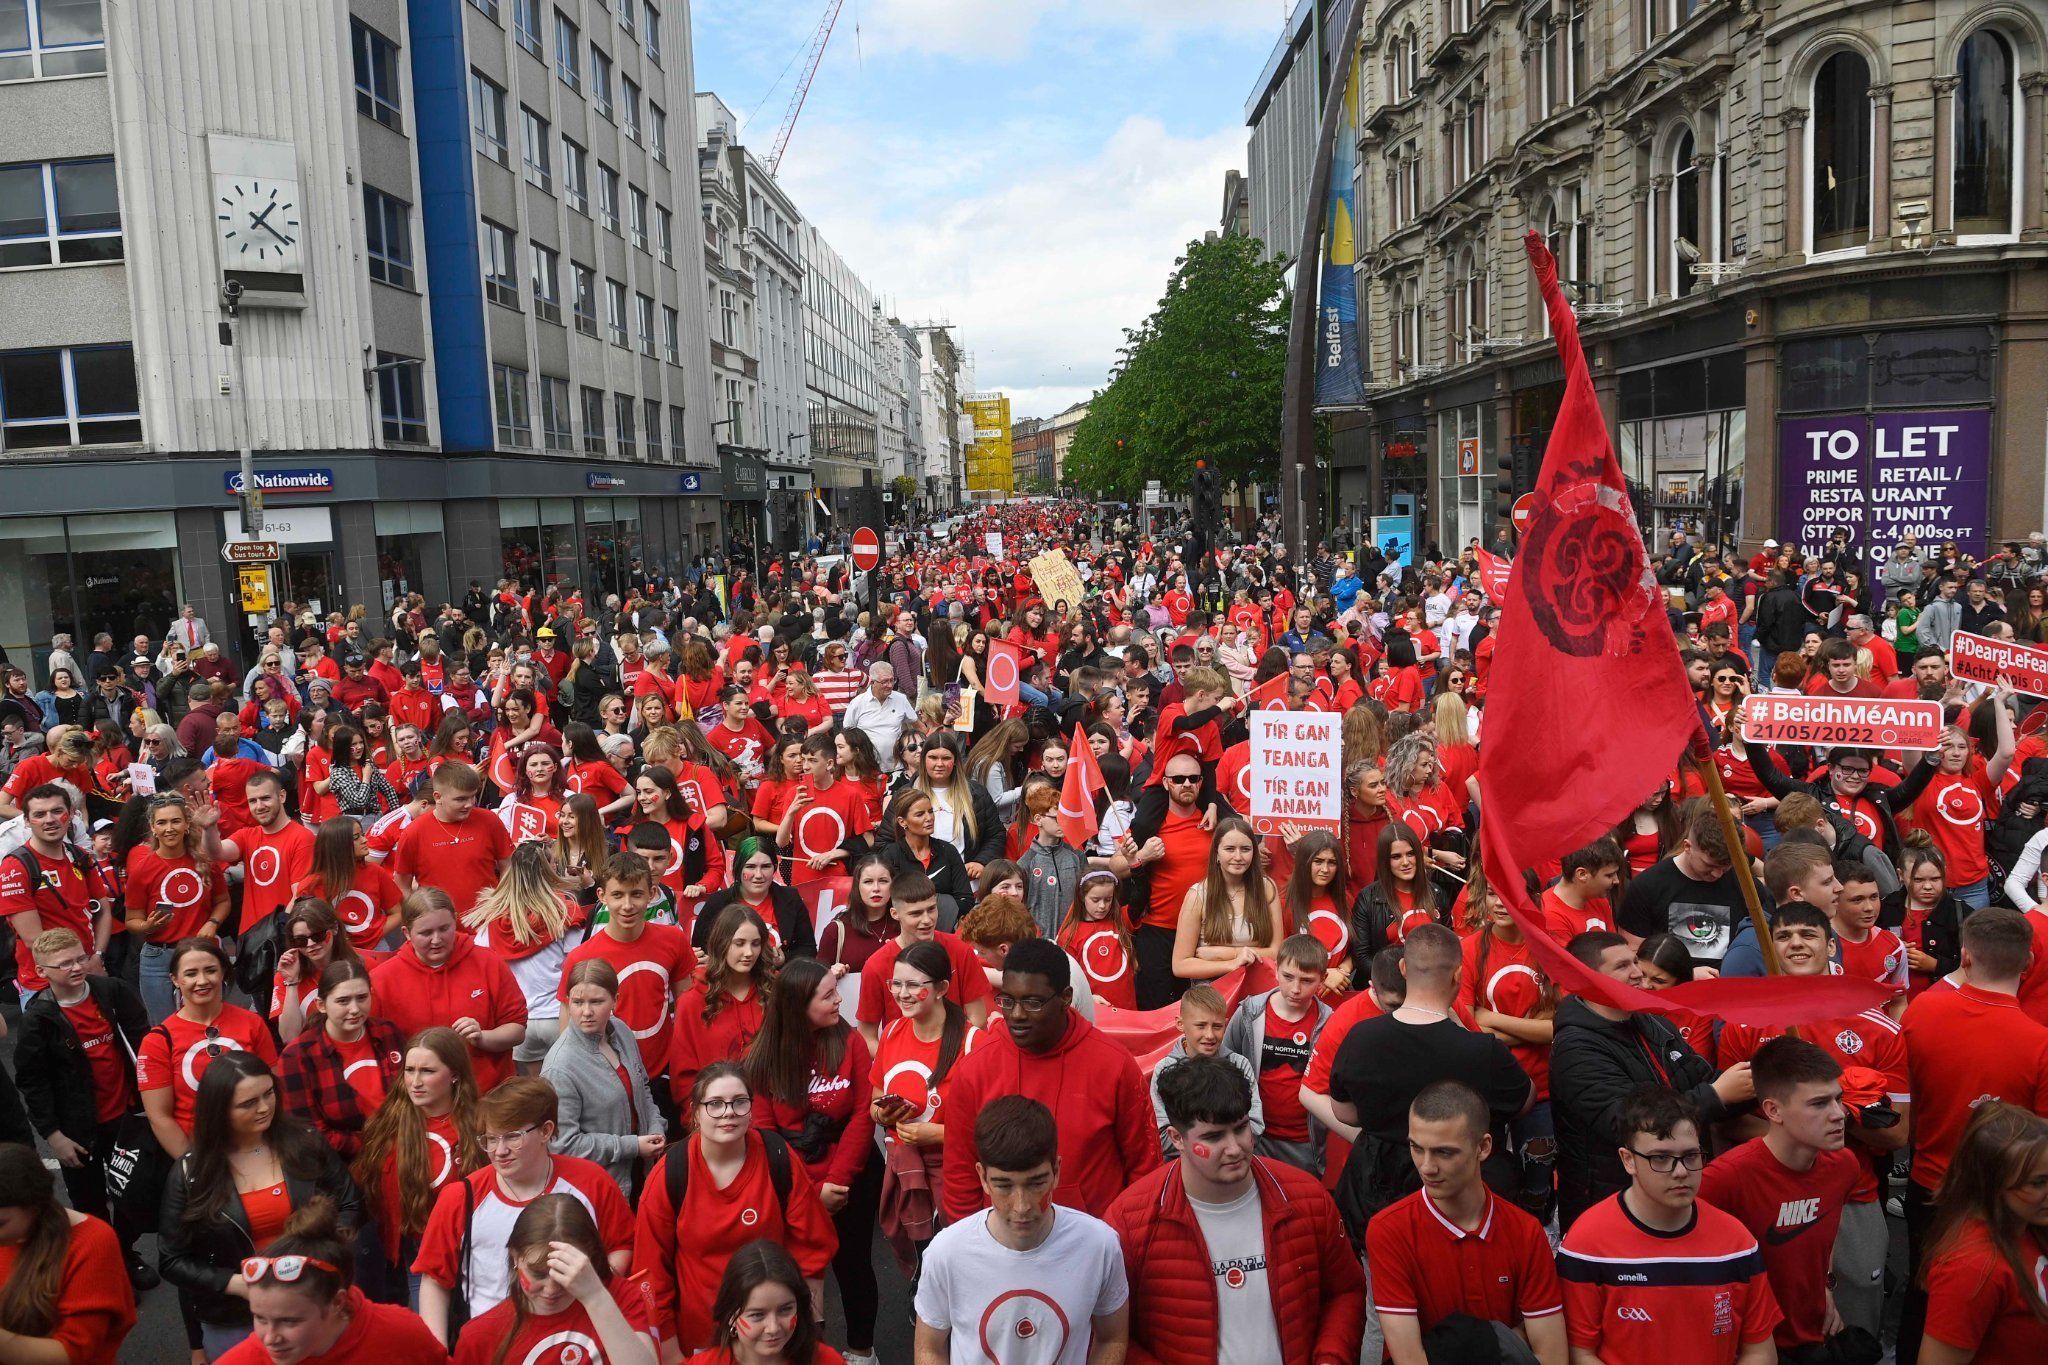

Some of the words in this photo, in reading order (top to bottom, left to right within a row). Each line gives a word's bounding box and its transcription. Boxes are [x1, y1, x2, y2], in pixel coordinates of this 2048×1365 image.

[1326, 307, 1341, 367] Belfast
[1806, 429, 1860, 461] TO
[1875, 426, 1959, 459] LET
[253, 473, 329, 488] Nationwide
[1806, 469, 1857, 484] PRIME
[1880, 467, 1951, 483] RETAIL
[1810, 489, 1865, 503] RESTA
[1871, 487, 1947, 502] URANT
[1803, 507, 1863, 522] OPPOR
[1872, 506, 1953, 521] TUNITY
[264, 523, 291, 532] 61-63
[1957, 528, 1972, 538] FT
[234, 544, 251, 552] Open
[1263, 719, 1288, 740] TÍR
[1294, 724, 1330, 741] GAN
[1752, 723, 1874, 743] 21/05/2022
[1262, 749, 1330, 768] TEANGA
[1263, 776, 1288, 796] TÍR
[1294, 780, 1329, 797] GAN
[1271, 798, 1321, 815] ANAM
[1275, 1046, 1296, 1054] NORTH
[1776, 1198, 1820, 1227] NIKE
[1617, 1307, 1652, 1322] GAA
